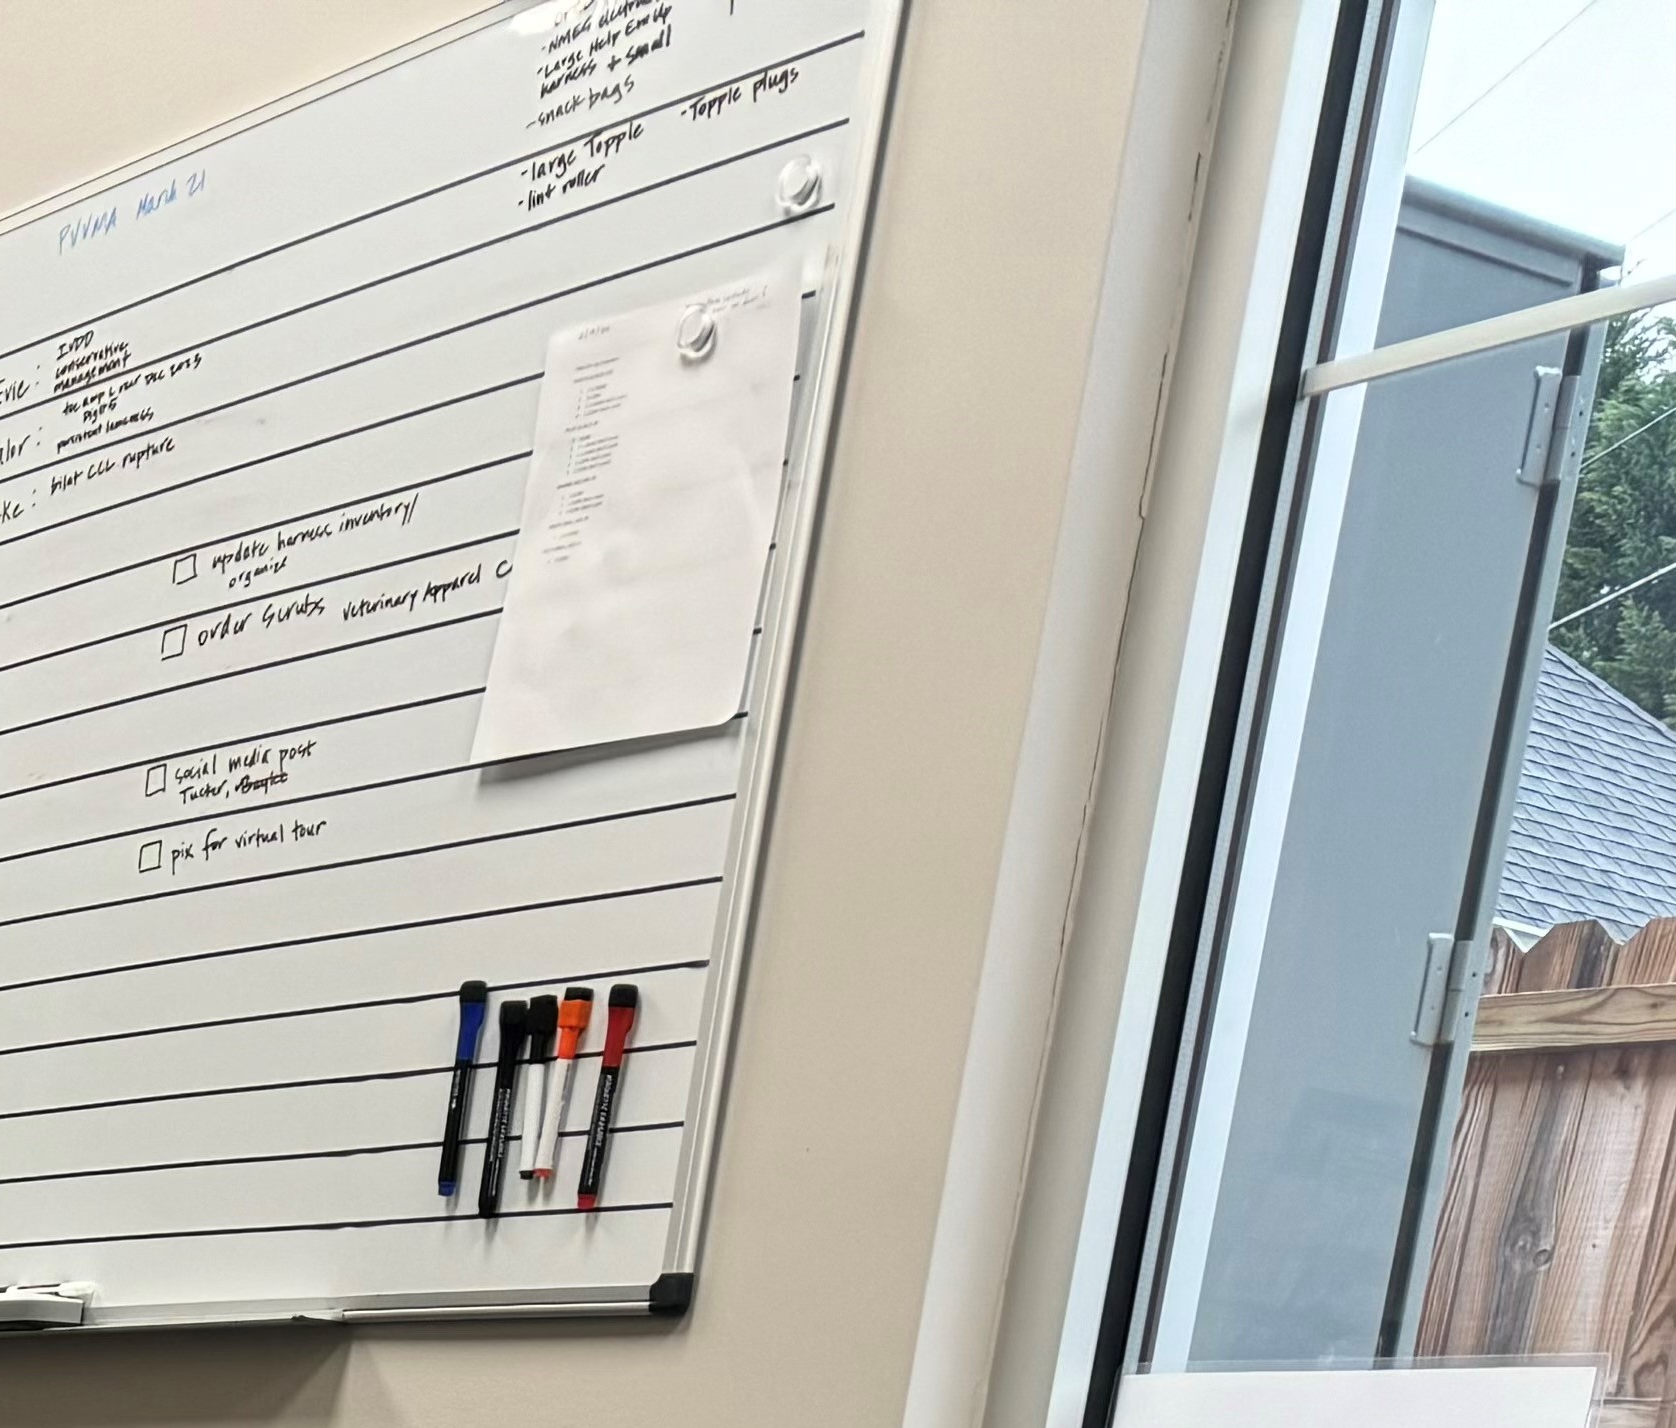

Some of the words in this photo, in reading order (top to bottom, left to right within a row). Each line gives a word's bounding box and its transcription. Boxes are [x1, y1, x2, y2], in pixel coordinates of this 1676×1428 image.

[589, 30, 621, 57] Help
[589, 74, 635, 109] bags
[752, 66, 800, 103] plugs
[584, 120, 644, 158] Topple
[561, 163, 606, 196] roller
[136, 179, 178, 221] March
[55, 341, 129, 380] conservative
[56, 329, 95, 362] IVDD
[54, 350, 131, 393] management
[87, 458, 117, 480] CCL
[121, 436, 176, 471] rupture
[211, 539, 270, 575] update
[277, 522, 333, 552] harness
[228, 556, 289, 588] organize
[197, 612, 252, 647] order
[422, 563, 482, 602] Apparel
[174, 754, 217, 785] social
[228, 744, 269, 774] media
[279, 740, 317, 772] post
[171, 841, 194, 876] pix
[202, 827, 228, 861] for
[235, 823, 284, 850] virtual
[291, 819, 328, 843] tour
